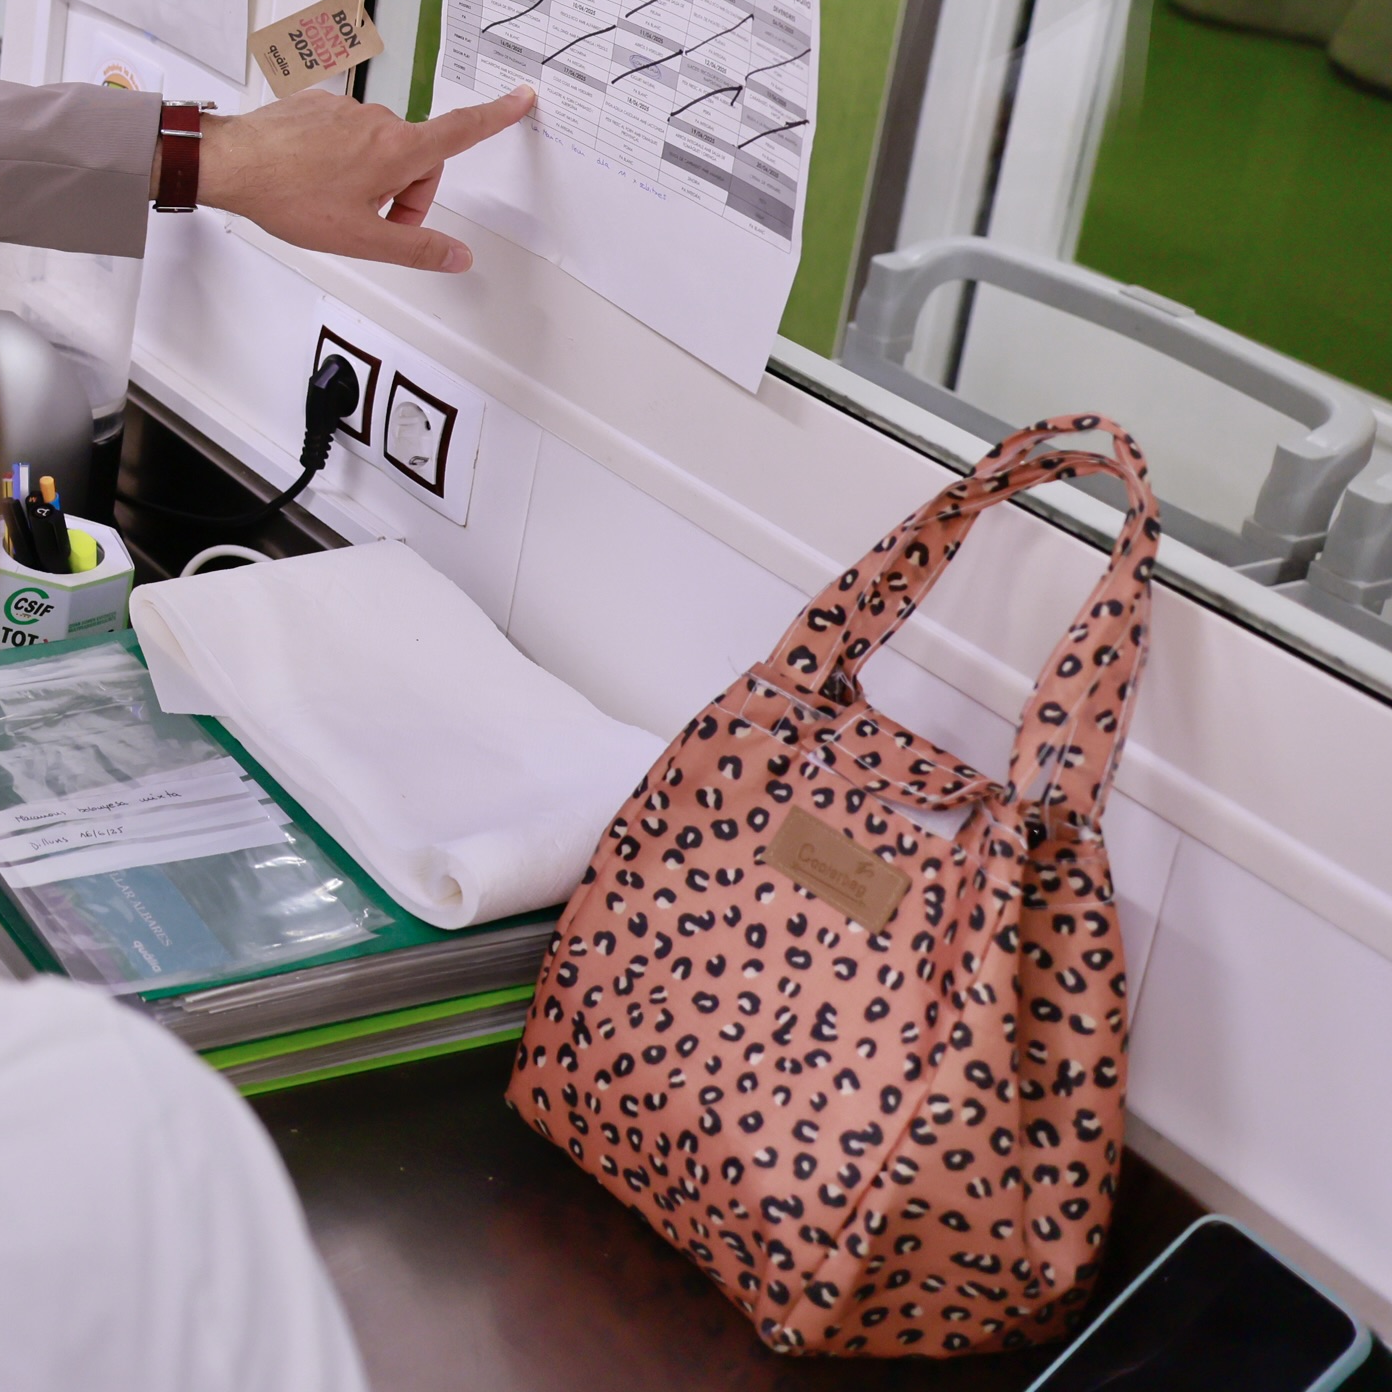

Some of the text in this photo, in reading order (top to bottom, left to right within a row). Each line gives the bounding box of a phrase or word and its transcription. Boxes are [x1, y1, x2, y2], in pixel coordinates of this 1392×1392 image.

[572, 1, 596, 16] 10/06/2025
[316, 12, 350, 58] SANT
[332, 10, 361, 49] BON
[639, 28, 664, 45] 11/06/2025
[288, 29, 320, 70] 2025
[299, 19, 337, 70] JORDI
[563, 66, 586, 82] 17/06/2025
[704, 57, 727, 75] 12/06/2025
[626, 95, 649, 112] 18/06/2025
[690, 126, 715, 145] 19/06/2025
[13, 597, 54, 617] CSIF
[1, 626, 39, 647] TOT
